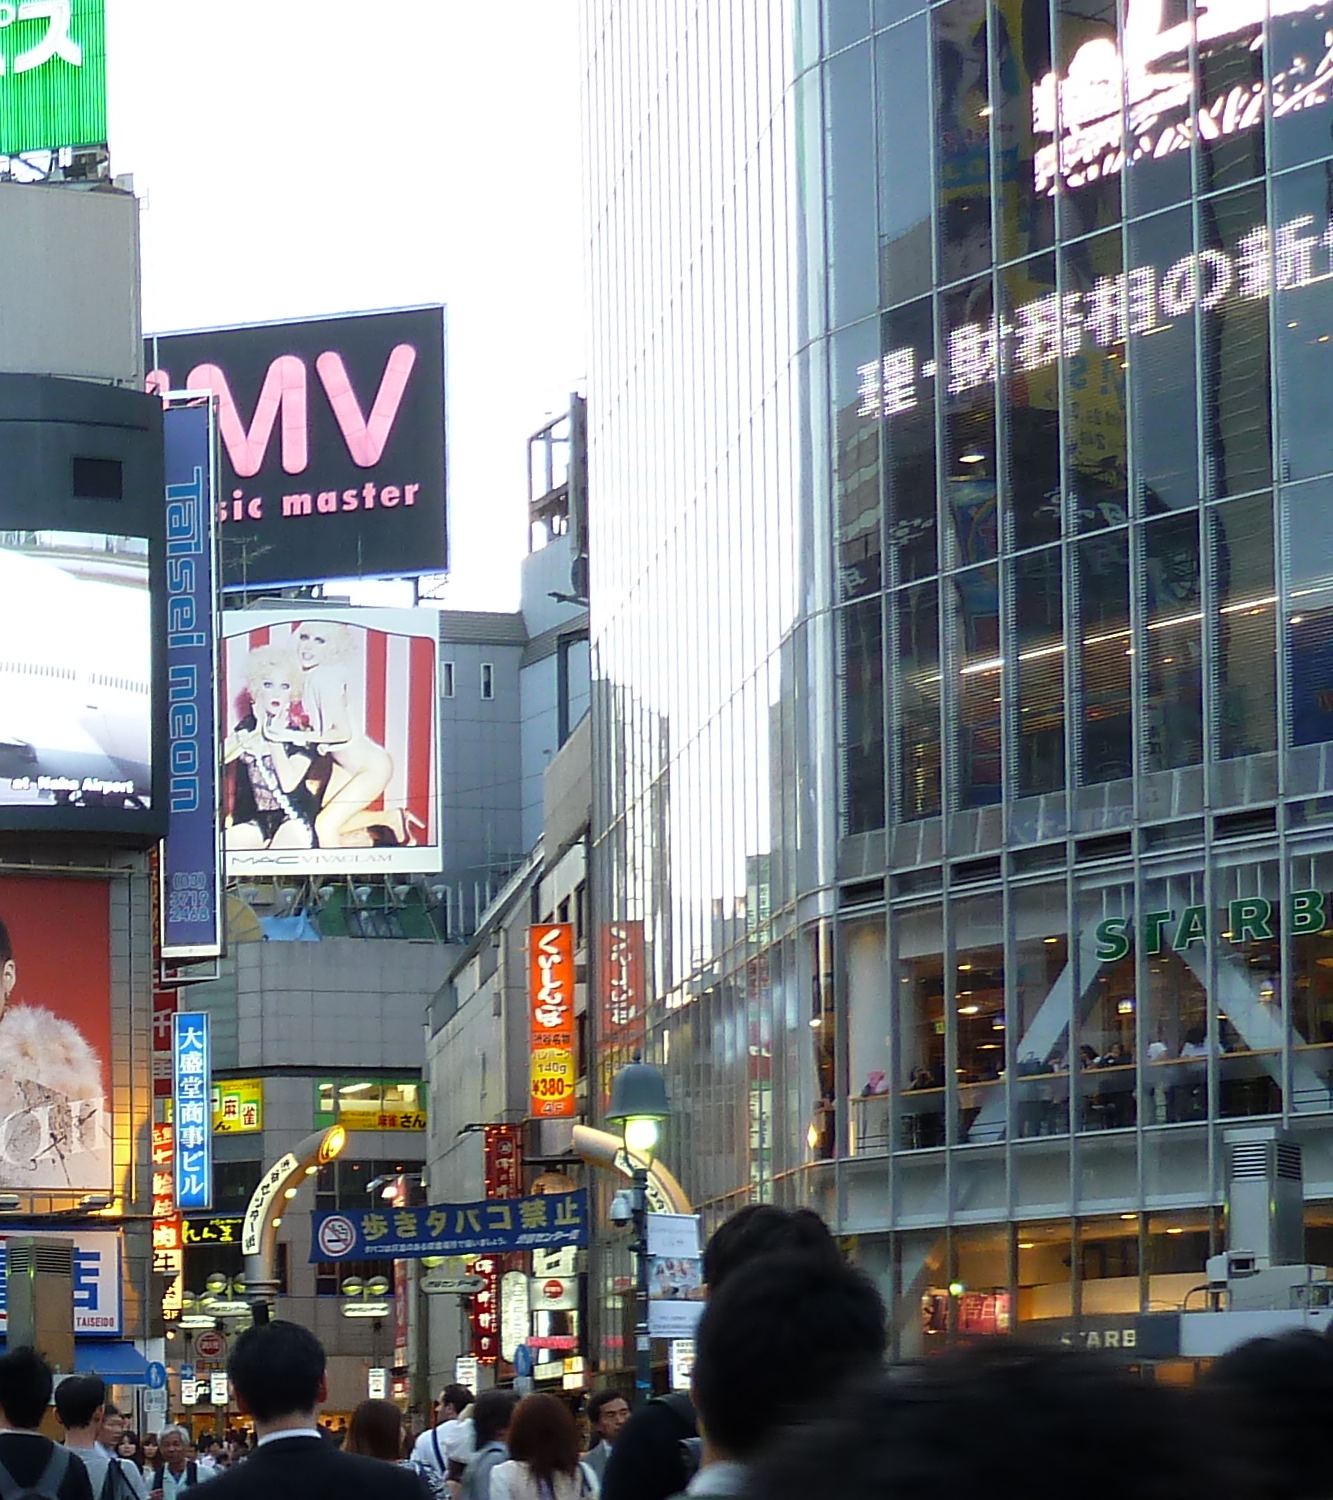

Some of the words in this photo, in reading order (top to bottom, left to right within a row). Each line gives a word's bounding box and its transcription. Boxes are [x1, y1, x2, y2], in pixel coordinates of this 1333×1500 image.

[856, 214, 1333, 418] 理・財務相の新
[145, 344, 417, 477] MV
[282, 482, 420, 517] master
[166, 466, 203, 649] Taisei
[169, 664, 199, 813] neon
[1095, 888, 1327, 963] STARB
[537, 1063, 567, 1074] 140g
[179, 1026, 204, 1196] 大盛堂商事ビル
[541, 1101, 565, 1115] 4F
[361, 1196, 581, 1241] 歩きタバコ禁止
[76, 1315, 115, 1328] TAISEIDO
[163, 1309, 180, 1320] 3F
